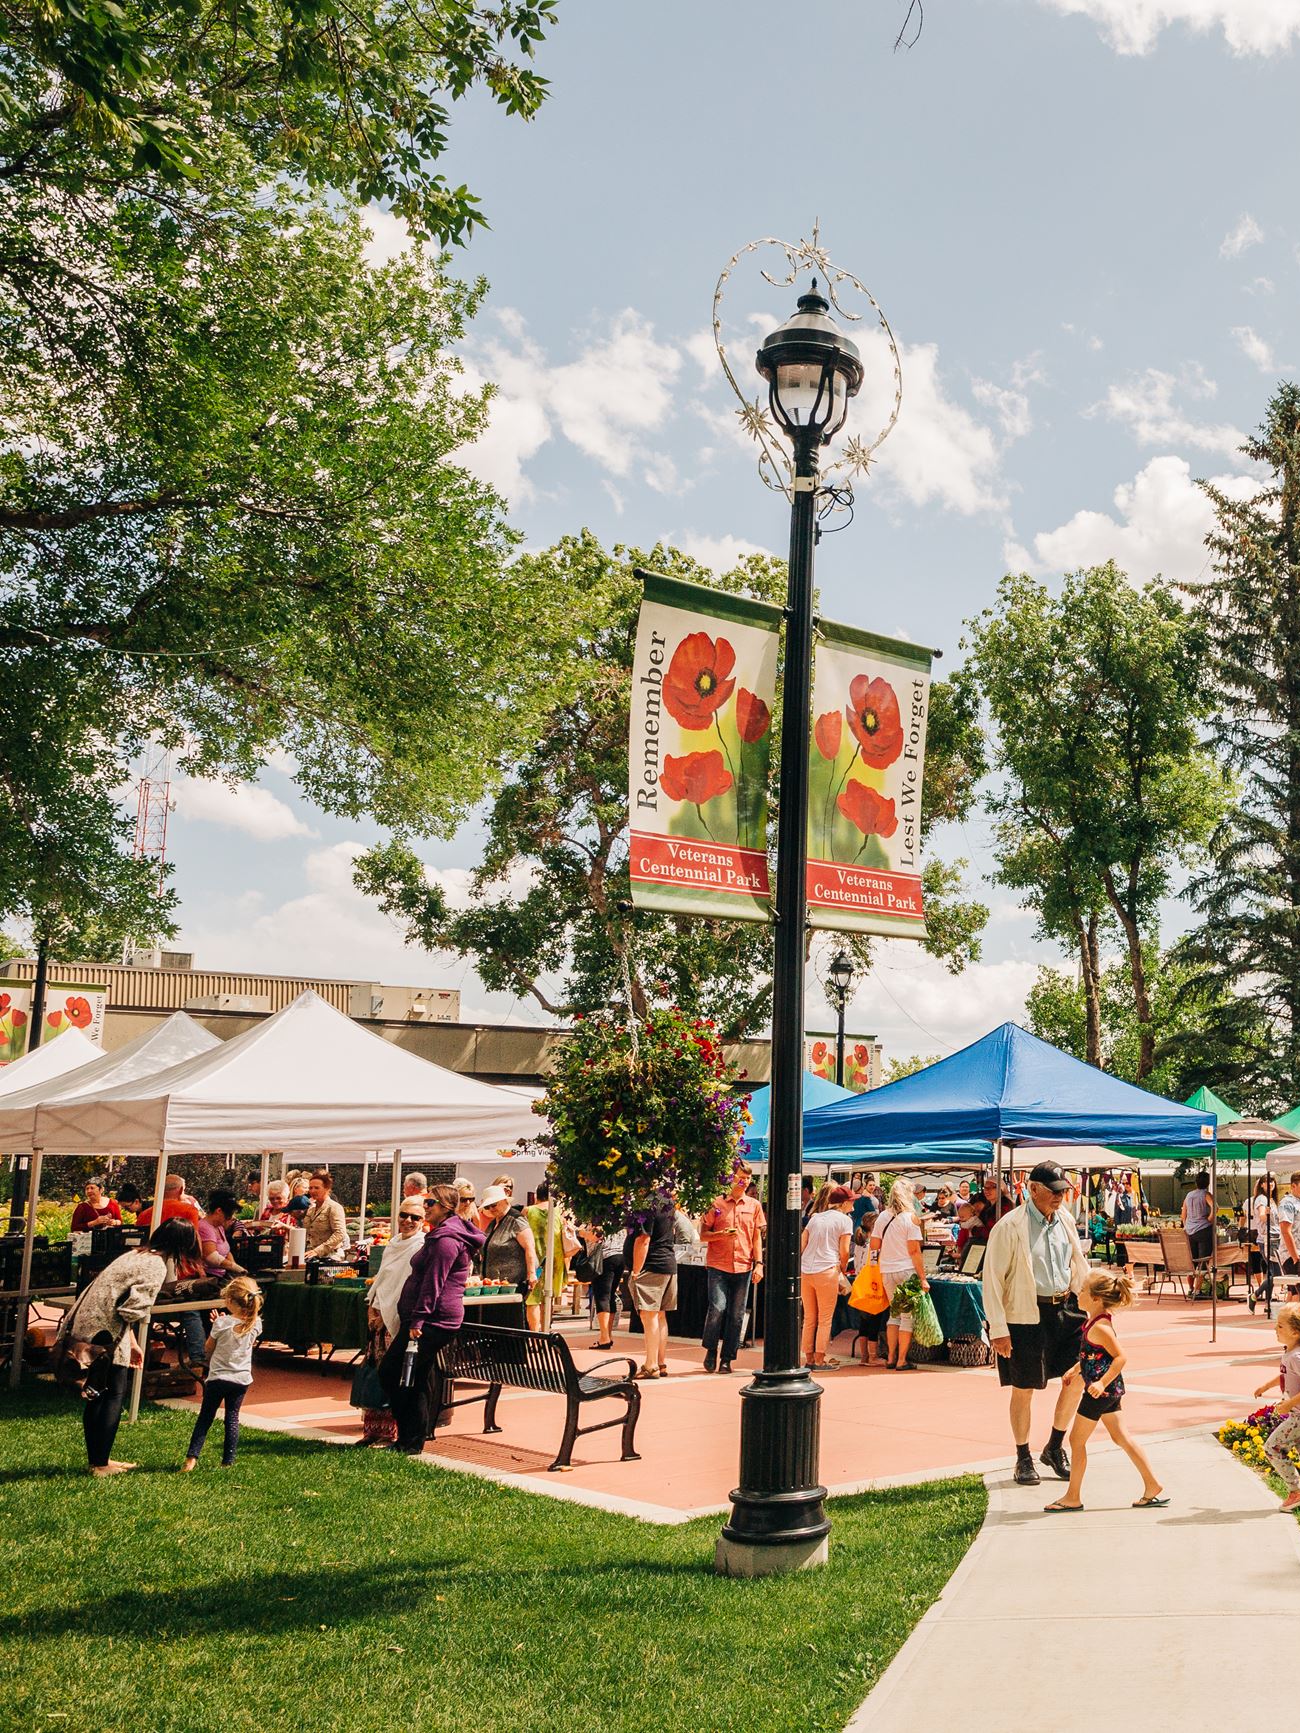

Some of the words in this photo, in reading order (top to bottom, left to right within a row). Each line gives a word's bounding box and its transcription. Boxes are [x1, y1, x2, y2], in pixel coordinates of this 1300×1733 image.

[636, 630, 666, 813] Remember
[904, 679, 925, 764] Forget
[901, 769, 917, 808] We
[900, 815, 914, 866] Lest
[667, 843, 734, 867] Veterans
[640, 858, 722, 884] Centennial
[726, 869, 760, 888] Park
[837, 870, 893, 892] Veterans
[814, 884, 884, 906] Centennial
[887, 894, 916, 910] Park
[93, 996, 102, 1024] Forget
[91, 1028, 99, 1040] We
[512, 1149, 536, 1157] Spring
